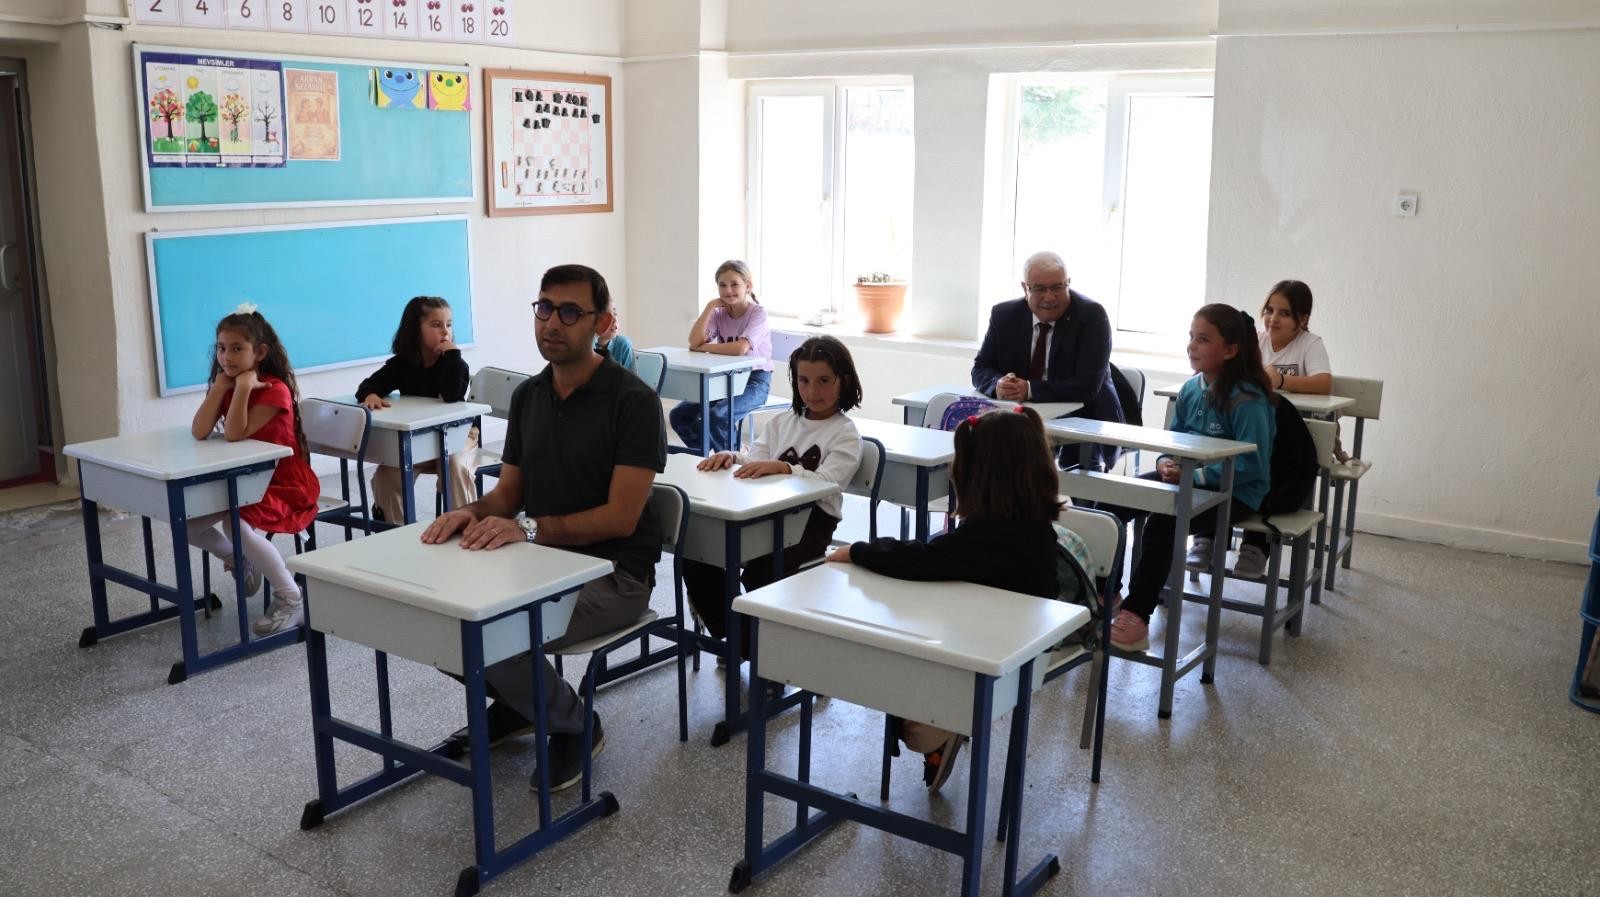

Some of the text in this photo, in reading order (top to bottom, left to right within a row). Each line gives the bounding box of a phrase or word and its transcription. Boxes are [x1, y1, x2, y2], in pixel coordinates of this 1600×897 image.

[196, 0, 208, 15] 4
[241, 0, 251, 18] 6
[283, 2, 292, 21] 8
[319, 5, 335, 23] 10
[358, 8, 373, 26] 12
[394, 12, 408, 29] 14
[429, 14, 441, 32] 16
[462, 17, 474, 33] 18
[491, 19, 508, 36] 20
